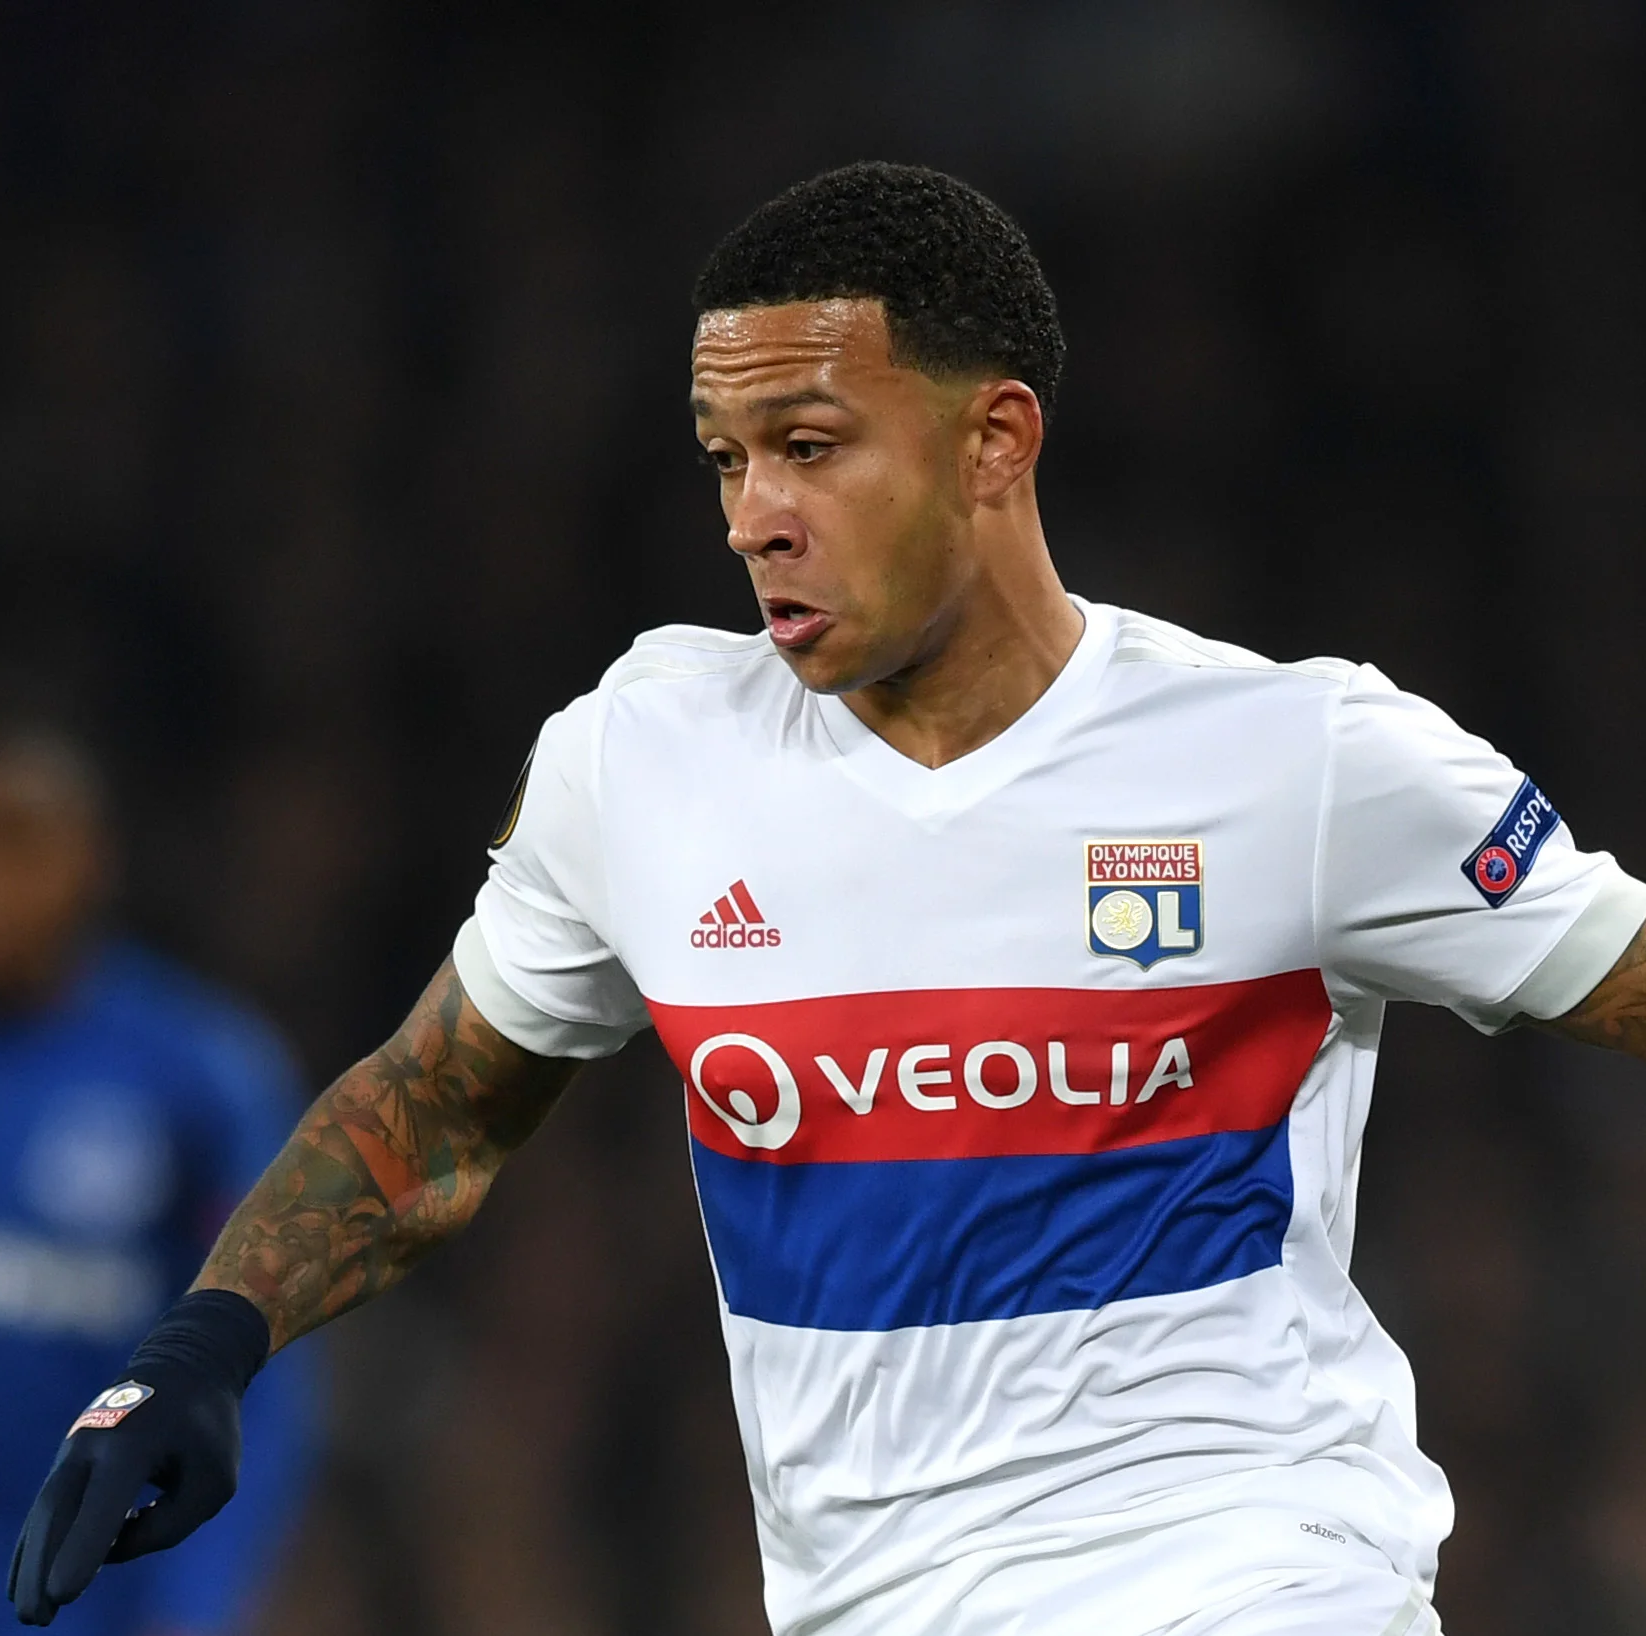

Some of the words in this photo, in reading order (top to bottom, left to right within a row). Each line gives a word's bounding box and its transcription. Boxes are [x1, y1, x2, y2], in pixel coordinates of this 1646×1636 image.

[1506, 788, 1552, 858] RESPE
[1091, 845, 1195, 862] OLYMPIQUE
[1091, 862, 1196, 879] LYONNAIS
[1092, 890, 1195, 950] OL
[690, 923, 782, 948] adidas
[813, 1037, 1196, 1115] VEOLIA
[1299, 1522, 1346, 1544] adizero
